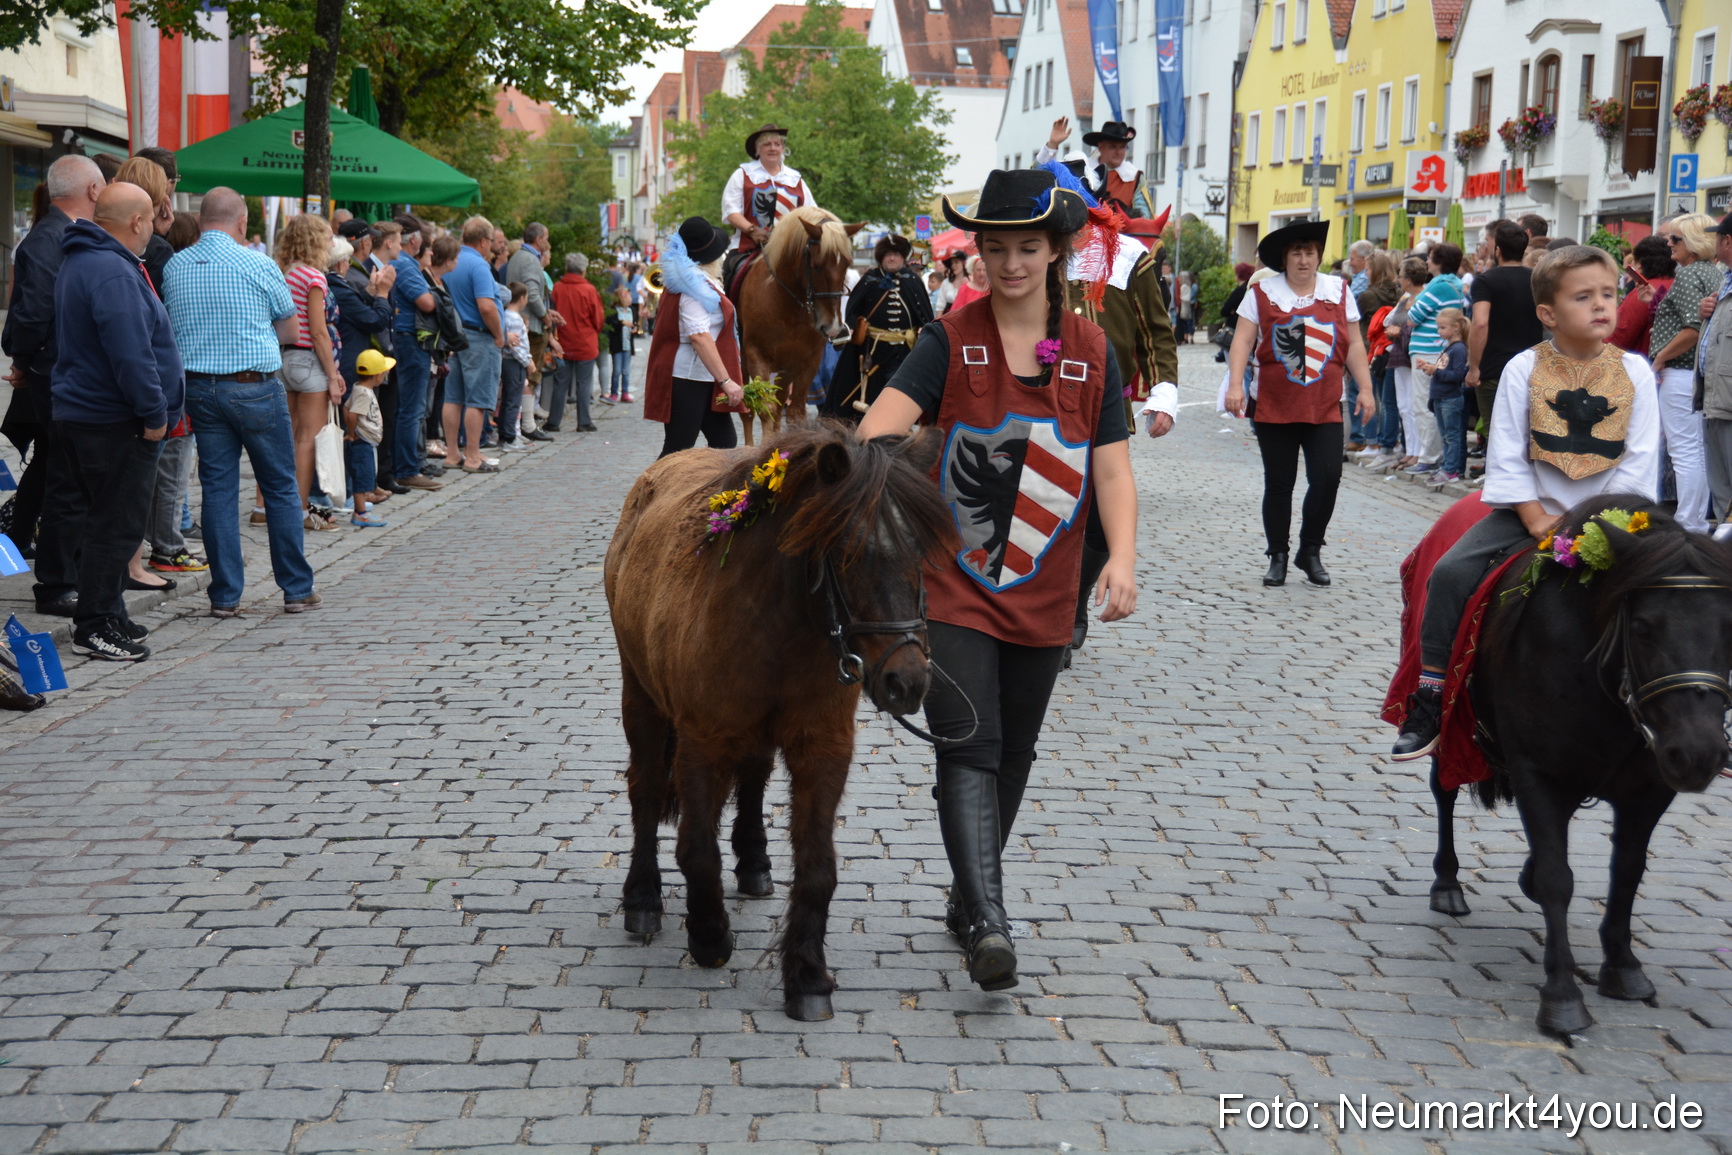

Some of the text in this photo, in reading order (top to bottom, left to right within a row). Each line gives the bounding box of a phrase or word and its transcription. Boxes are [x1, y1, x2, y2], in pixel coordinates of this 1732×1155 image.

[1158, 25, 1174, 72] K&L
[1100, 41, 1118, 85] K&L
[1281, 72, 1305, 97] HOTEL
[242, 156, 379, 173] Lammbräu
[262, 151, 362, 163] Neumkter
[1304, 177, 1335, 185] TAFUN
[1676, 158, 1692, 189] P
[1273, 189, 1307, 206] Restaurant
[88, 635, 131, 657] alpina
[36, 653, 51, 690] Lebenshilfe
